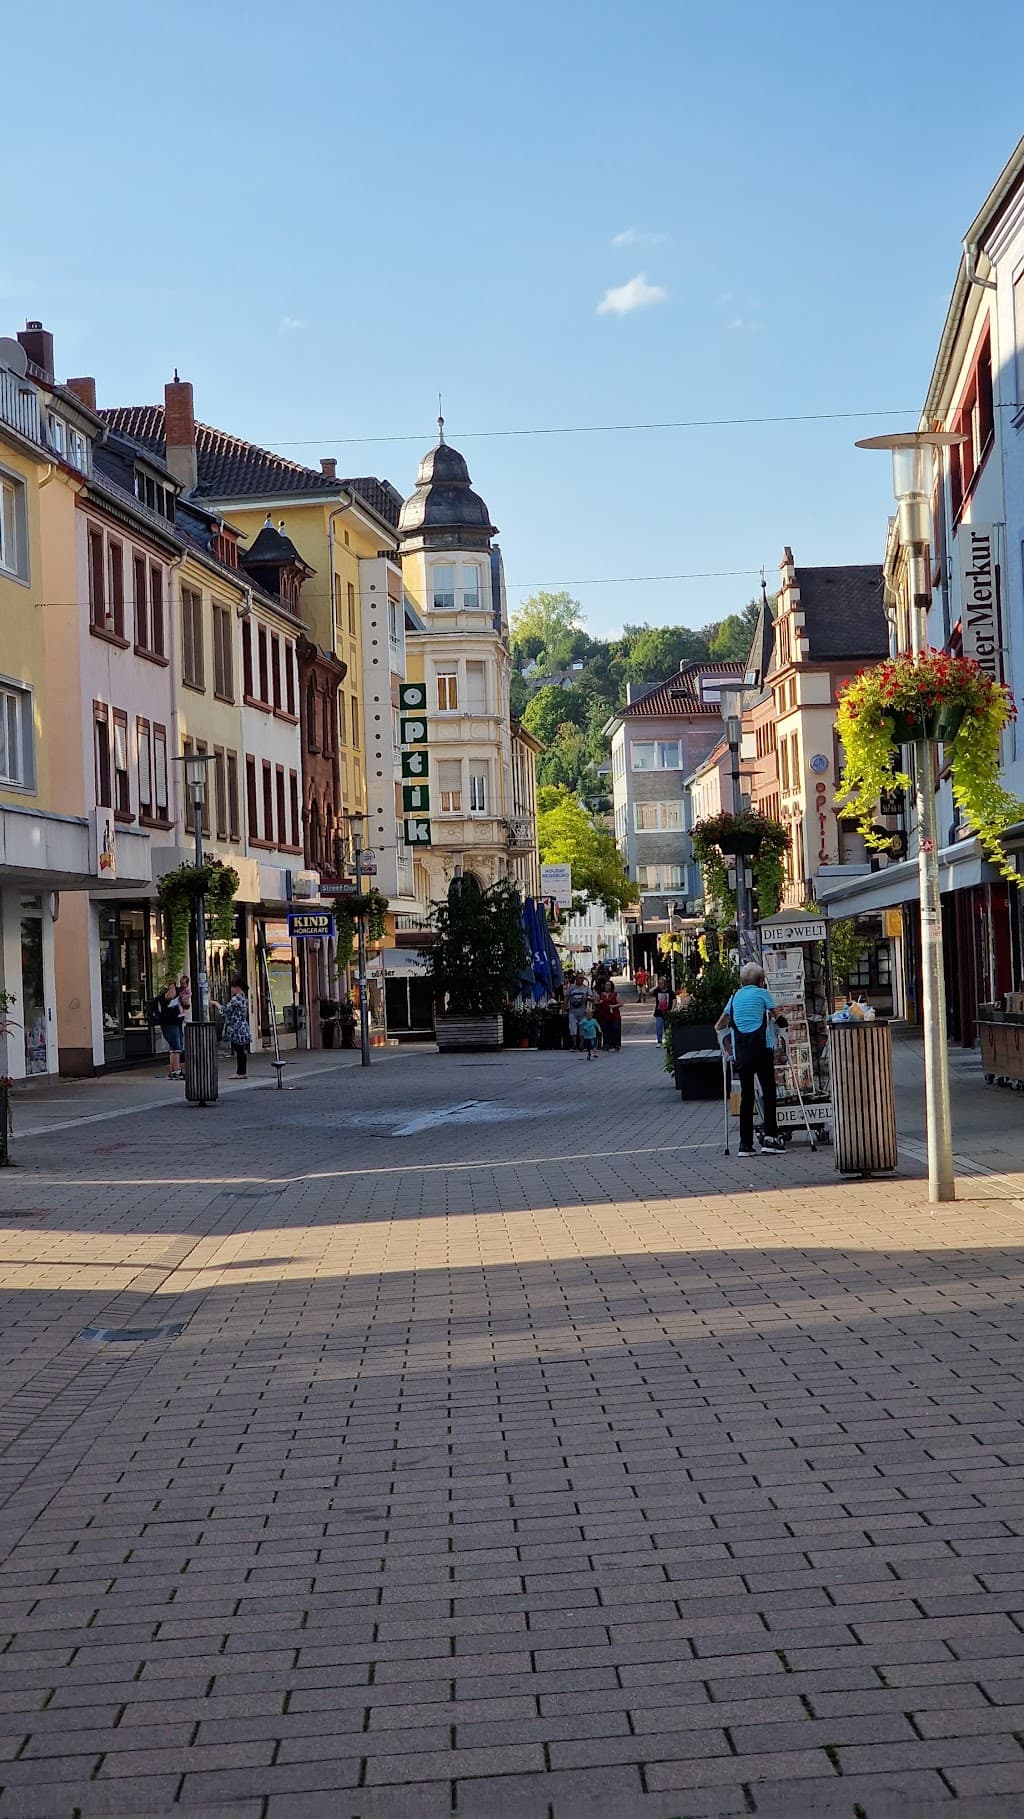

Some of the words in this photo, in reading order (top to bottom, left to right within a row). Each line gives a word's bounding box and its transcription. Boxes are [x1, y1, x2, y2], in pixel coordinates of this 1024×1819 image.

[965, 531, 994, 630] Merkur
[402, 688, 428, 841] optik
[293, 916, 329, 927] KIND
[764, 929, 783, 940] DIE
[794, 926, 824, 937] WELT
[777, 1111, 796, 1122] DIE
[807, 1108, 832, 1120] WEL
